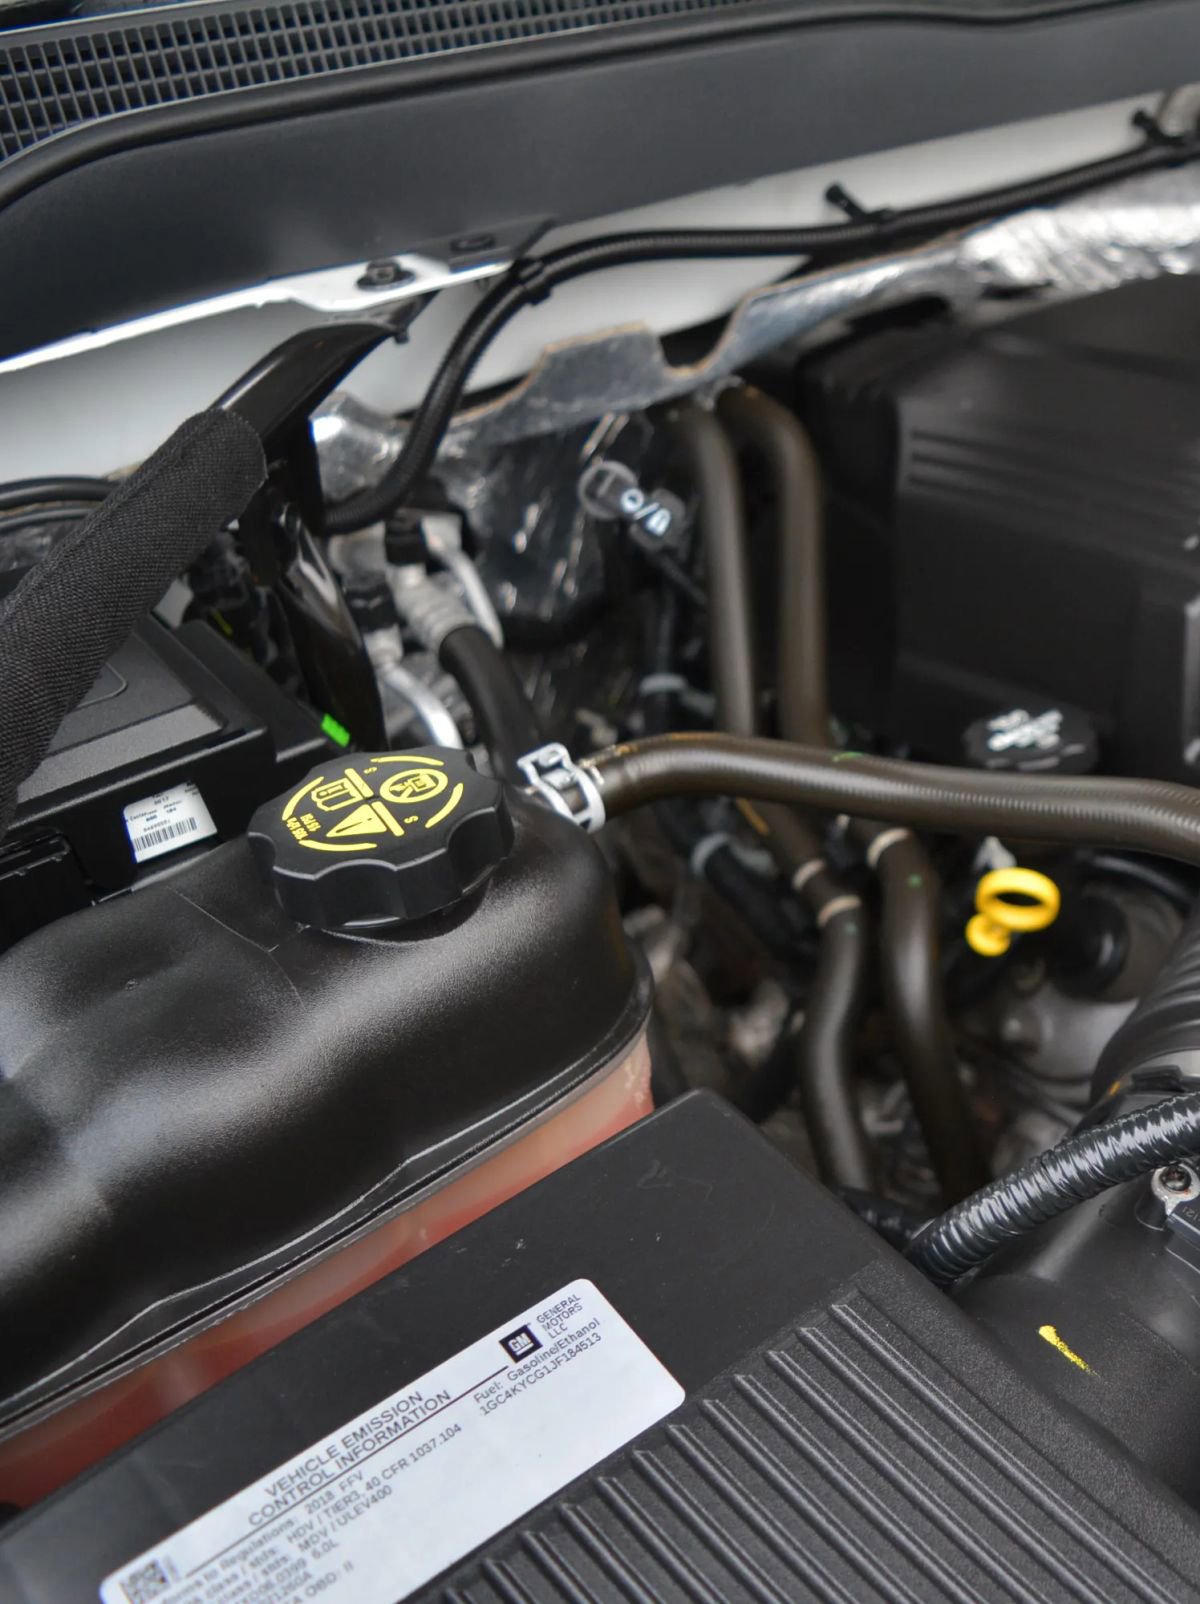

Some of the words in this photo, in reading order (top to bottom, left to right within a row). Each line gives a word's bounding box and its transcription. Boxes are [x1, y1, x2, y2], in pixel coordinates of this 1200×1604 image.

[536, 1294, 581, 1324] GENERAL
[542, 1303, 583, 1332] MOTORS
[508, 1332, 533, 1350] GM
[548, 1323, 568, 1339] LLC
[473, 1382, 503, 1403] Fuel:
[507, 1318, 600, 1381] Gasoline/Ethanol
[480, 1332, 601, 1416] 1GC4KYCG1JF184513
[248, 1469, 335, 1526] CONTROL
[335, 1390, 450, 1469] INFORMATION
[265, 1445, 340, 1497] VEHICLE
[341, 1391, 423, 1449] EMISSION
[365, 1477, 381, 1491] 40
[381, 1458, 410, 1480] CFR
[409, 1424, 462, 1462] 1037.104
[305, 1491, 335, 1514] 2018
[339, 1471, 363, 1491] FFV
[336, 1485, 393, 1526] ULEV400
